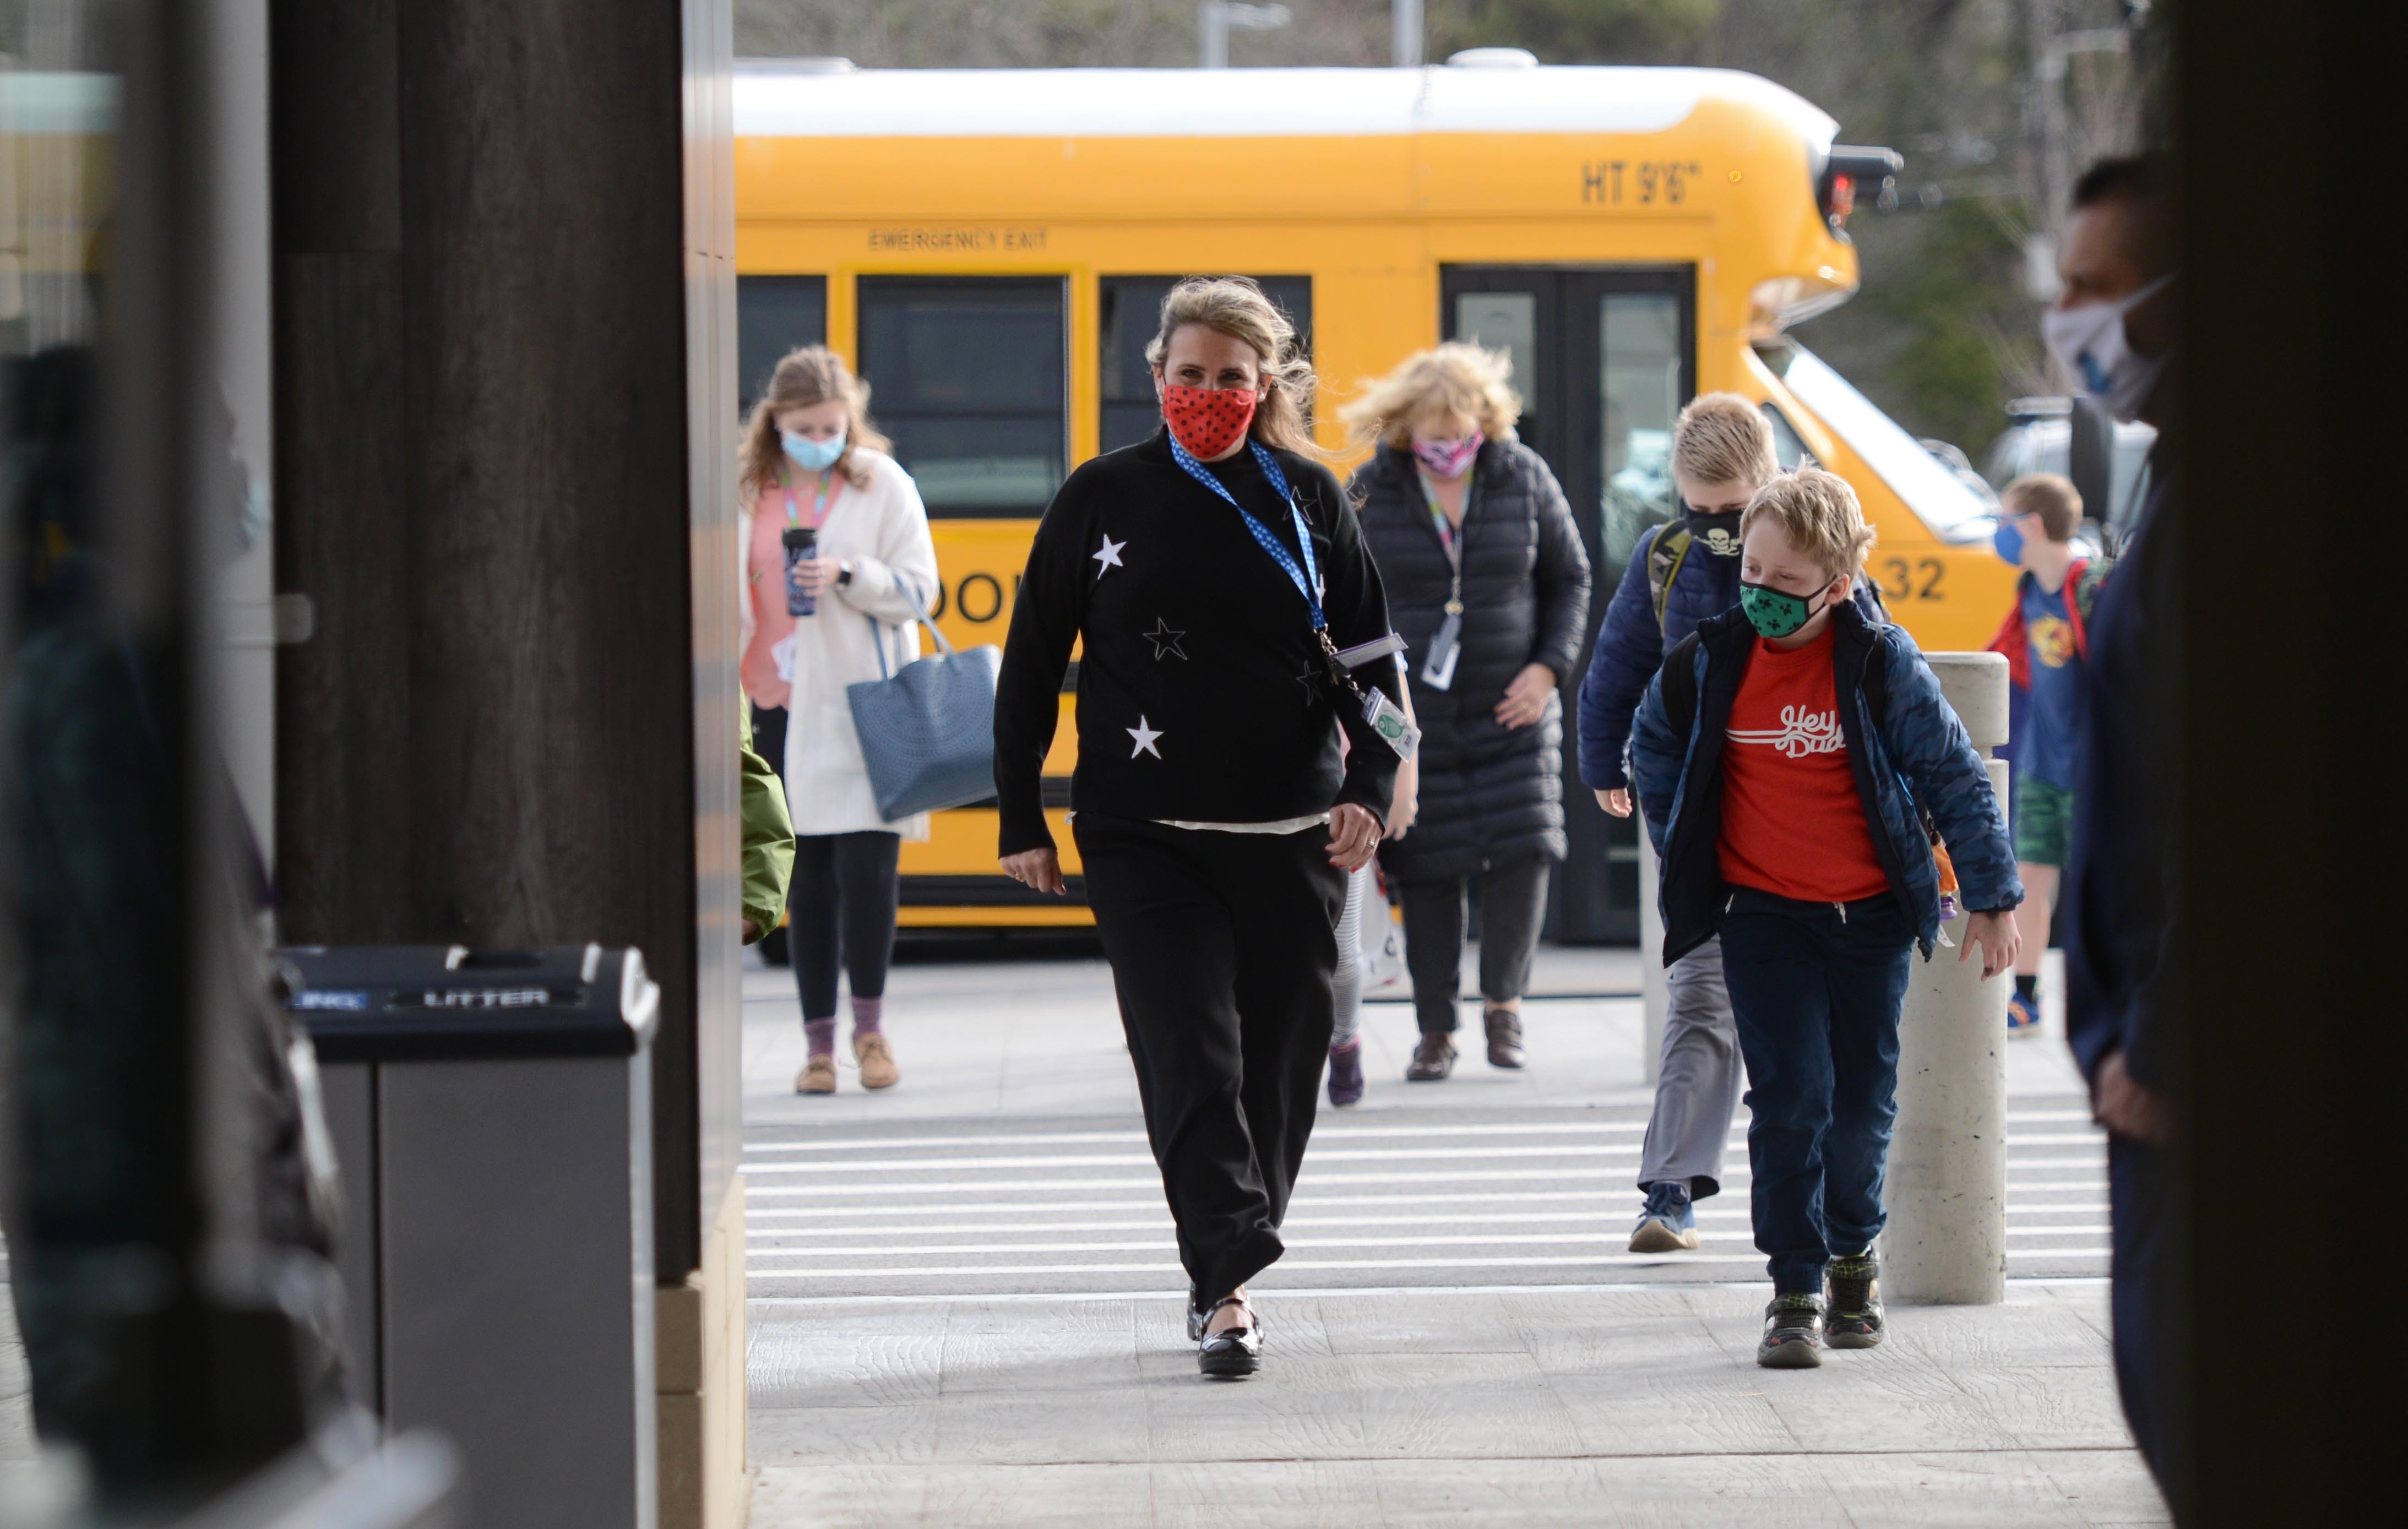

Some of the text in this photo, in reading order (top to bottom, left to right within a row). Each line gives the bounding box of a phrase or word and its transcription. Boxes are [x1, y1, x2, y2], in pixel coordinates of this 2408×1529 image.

[1581, 159, 1628, 204] HT
[869, 228, 1047, 252] EMERGENCY EXIT
[1884, 557, 1947, 602] 32
[1775, 723, 1847, 758] Dud
[1780, 705, 1835, 741] Hey
[423, 987, 549, 1008] LITTER
